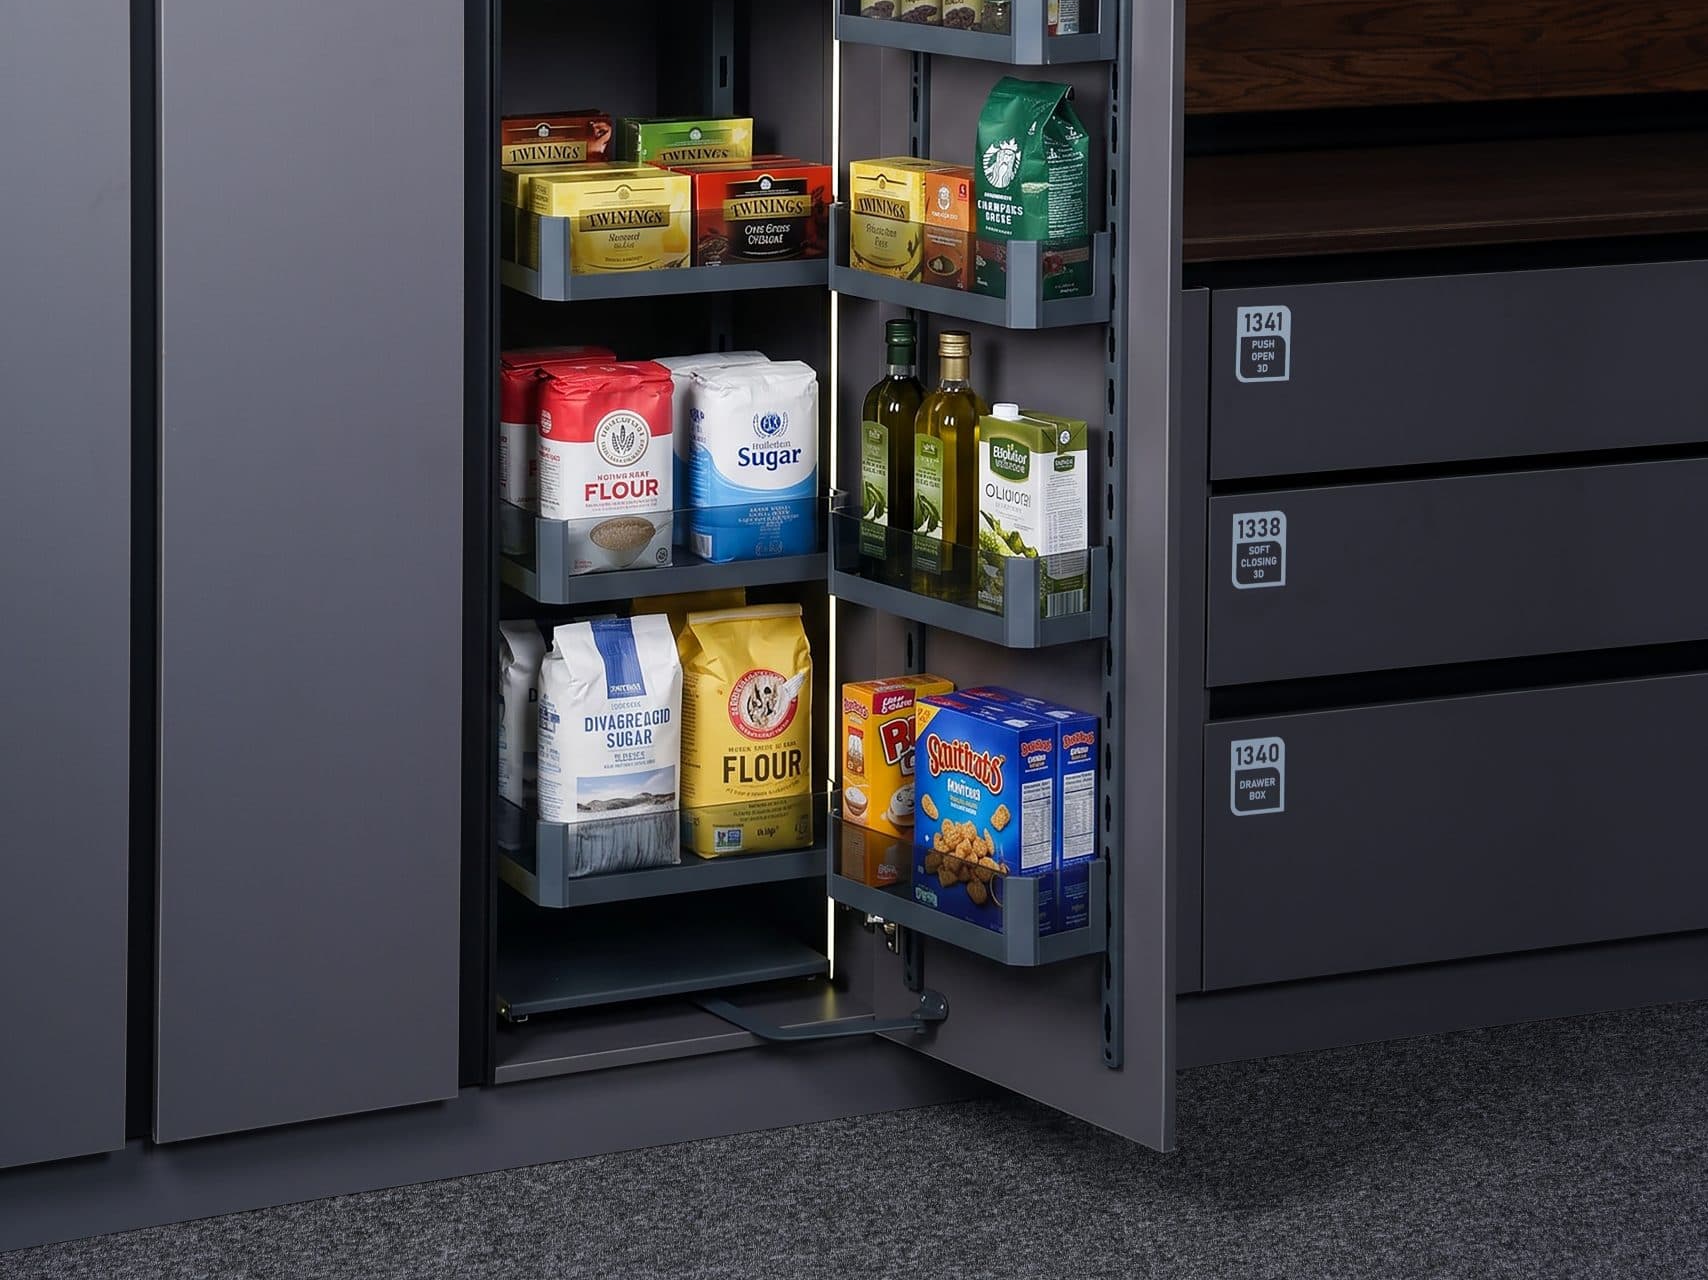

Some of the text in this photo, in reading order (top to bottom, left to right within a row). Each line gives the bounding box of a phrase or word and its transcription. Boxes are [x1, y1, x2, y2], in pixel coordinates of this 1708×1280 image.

[510, 145, 580, 162] TWININGS
[661, 148, 728, 162] TWININGS
[730, 197, 803, 217] TWININGS
[858, 197, 905, 219] TWININGS
[586, 209, 663, 228] TWININGS
[1244, 311, 1282, 332] 1341
[1251, 340, 1275, 349] PUSH
[1251, 352, 1275, 361] OPEN
[1256, 364, 1268, 373] 3D
[738, 447, 801, 471] Sugar
[584, 478, 659, 502] FLOUR
[1238, 517, 1280, 539] 1338
[1248, 545, 1271, 555] SOFT
[1241, 556, 1277, 568] CLOSING
[1253, 570, 1264, 579] 3D
[607, 729, 652, 748] SUGAR
[1235, 743, 1279, 766] 1340
[723, 749, 802, 784] FLOUR
[1240, 777, 1276, 789] DRAWER
[1249, 790, 1266, 800] BOX
